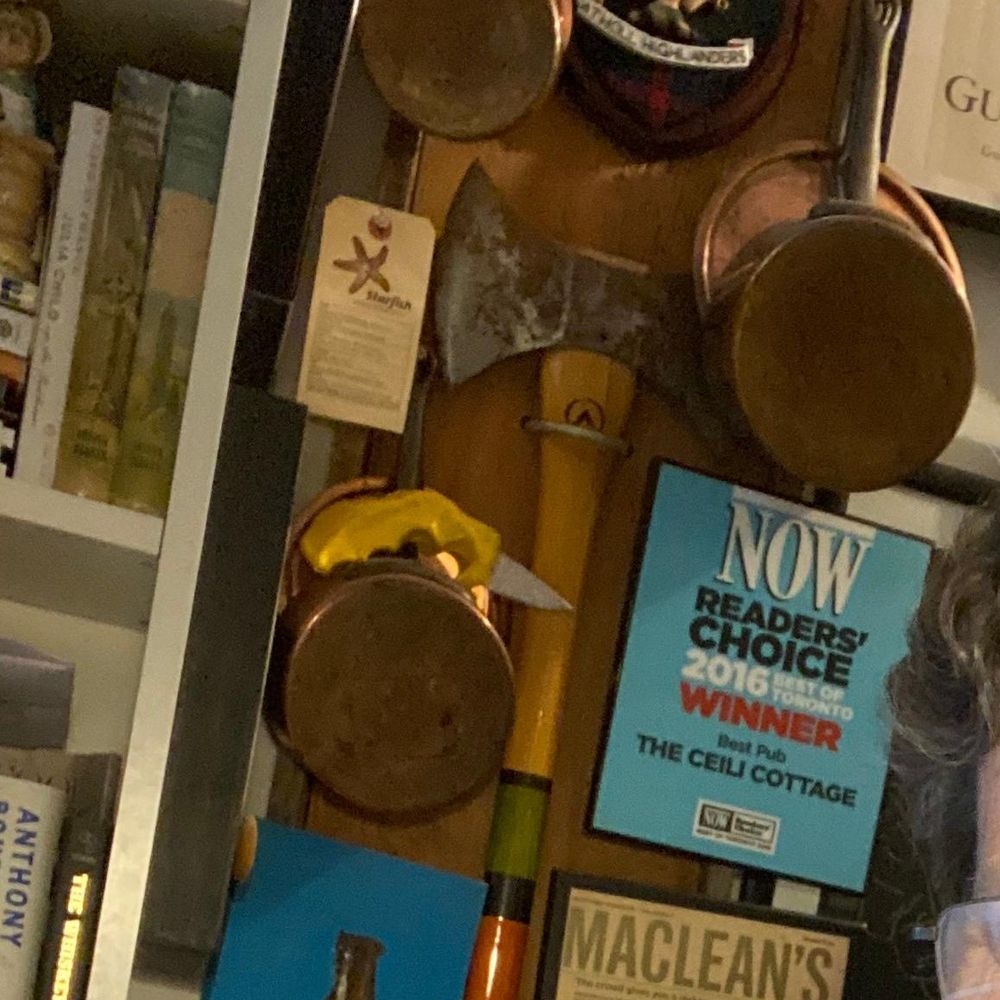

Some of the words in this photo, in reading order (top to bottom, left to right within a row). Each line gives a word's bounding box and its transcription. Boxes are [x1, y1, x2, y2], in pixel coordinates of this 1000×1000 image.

[641, 37, 748, 66] HIGHLANDERS
[714, 500, 874, 616] NOW
[681, 649, 769, 697] 2016
[687, 616, 854, 688] CHOICE
[772, 687, 854, 722] TORONTO
[819, 683, 846, 702] OF
[679, 681, 842, 754] WINNER
[636, 733, 684, 765] THE
[687, 747, 746, 781] CEILI
[749, 763, 858, 809] COTTAGE
[716, 732, 752, 757] Best
[755, 743, 787, 765] Pub
[1, 806, 40, 949] ANTHONY
[67, 872, 89, 916] THE
